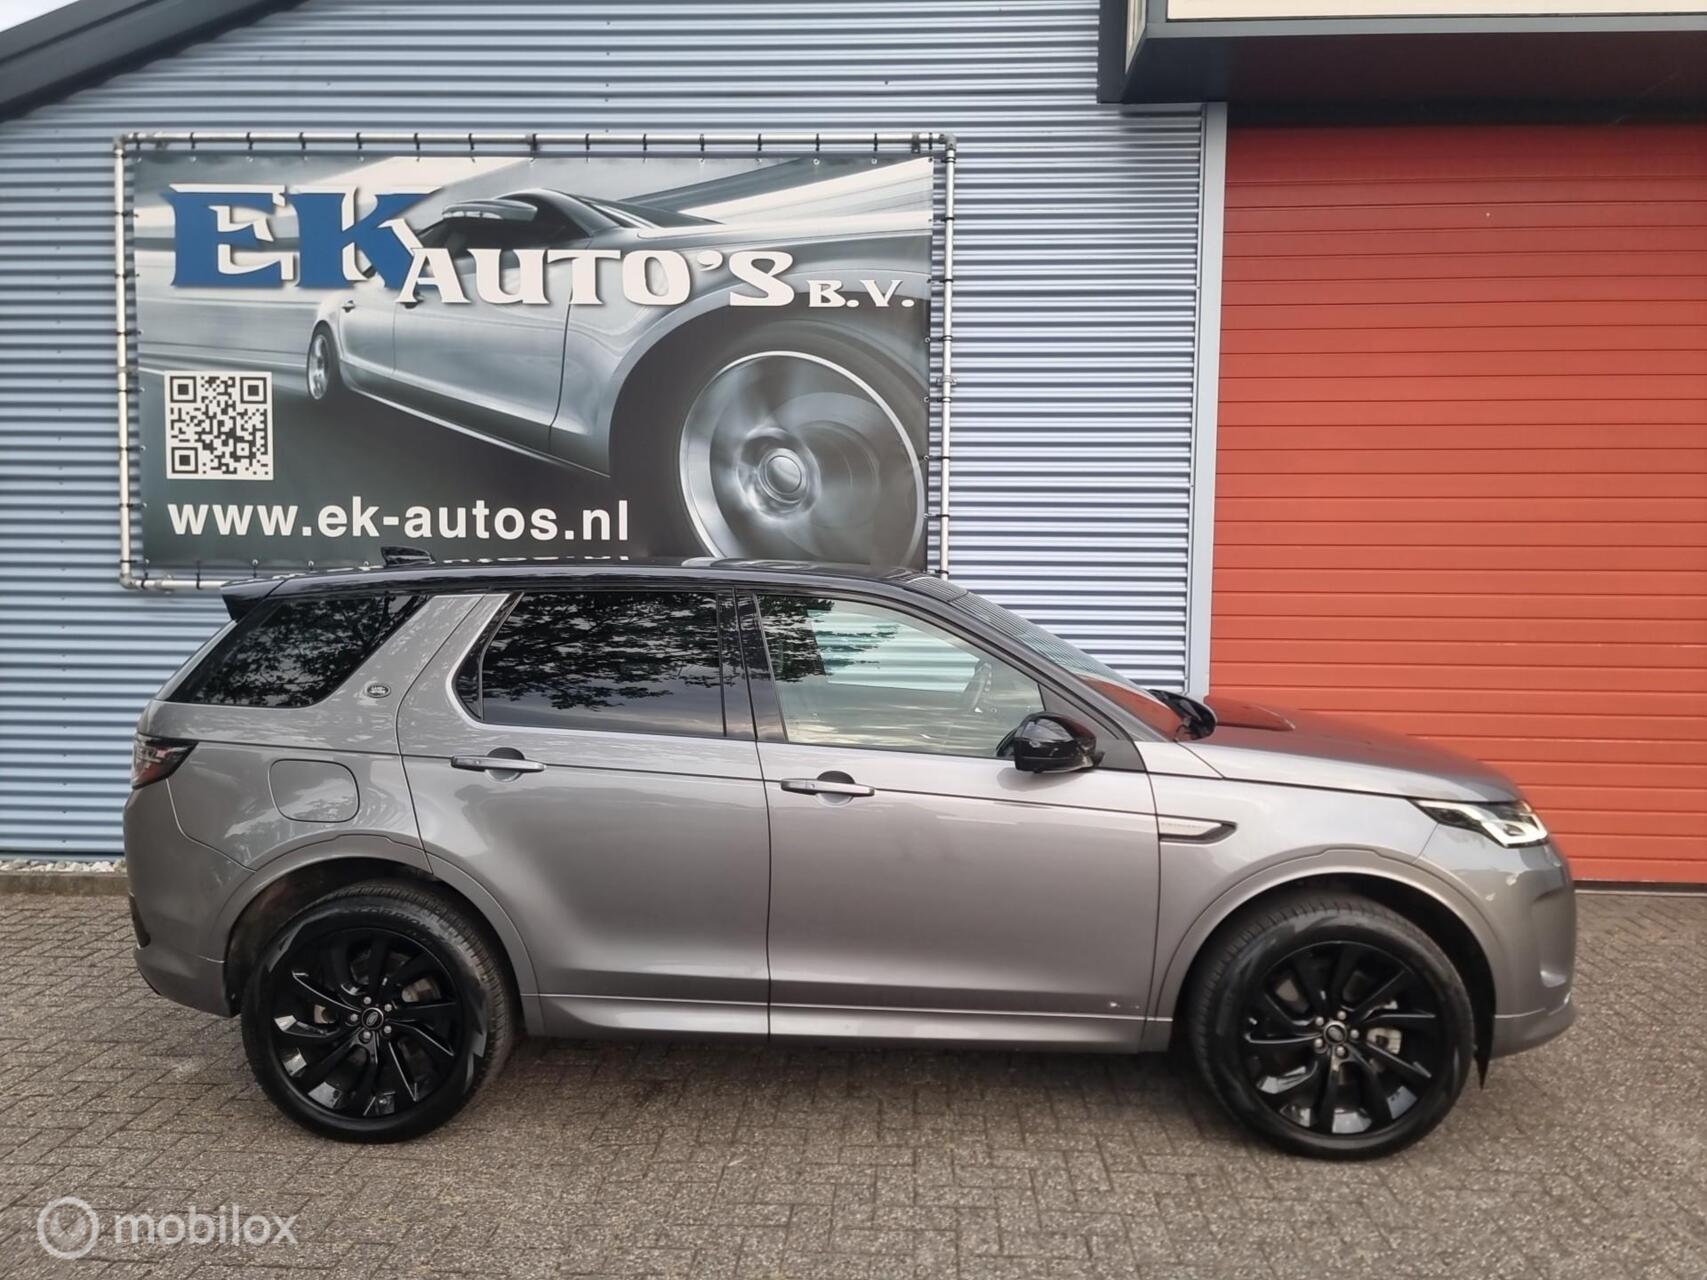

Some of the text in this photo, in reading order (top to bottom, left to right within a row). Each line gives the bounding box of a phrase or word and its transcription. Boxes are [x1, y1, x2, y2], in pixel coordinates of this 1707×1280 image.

[162, 184, 915, 308] EK AUTO'S B.V.
[167, 496, 629, 541] www.ek-autos.nl
